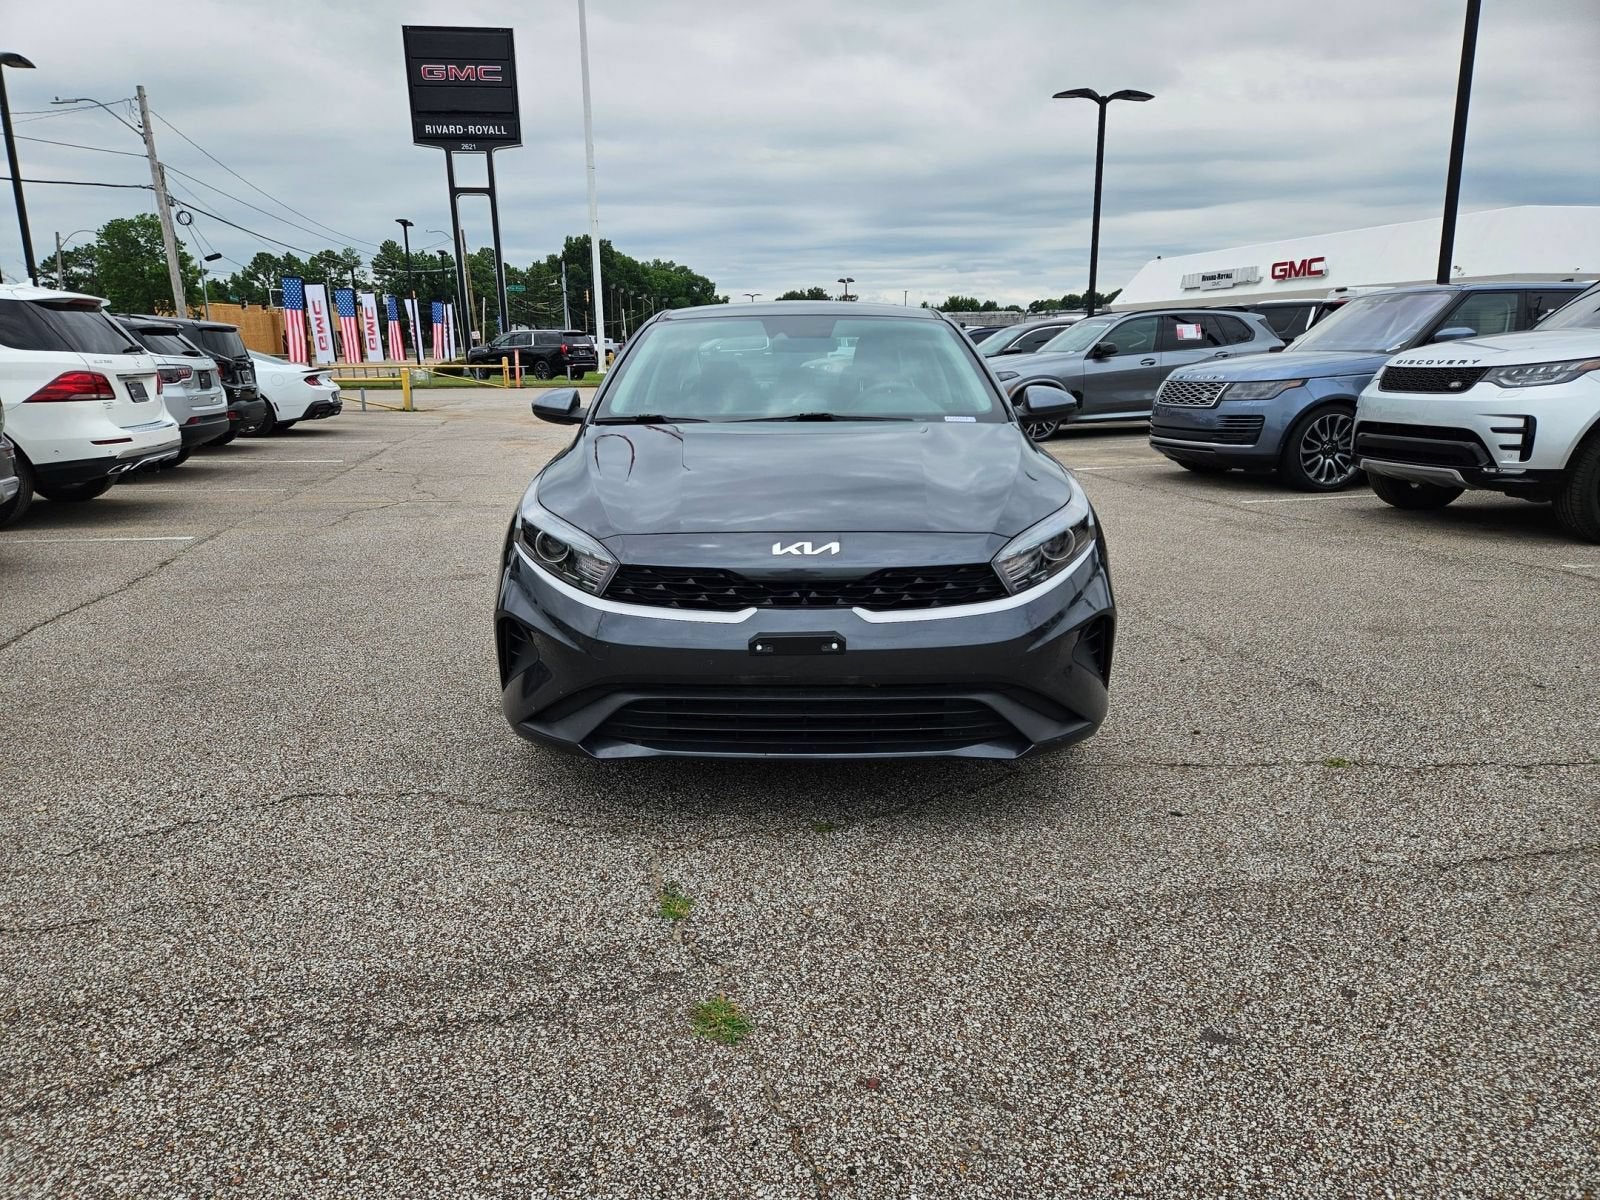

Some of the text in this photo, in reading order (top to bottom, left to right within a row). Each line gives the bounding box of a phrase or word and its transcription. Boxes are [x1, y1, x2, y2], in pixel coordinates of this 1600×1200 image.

[421, 64, 502, 81] GMC
[425, 124, 507, 134] RIVARD-ROYALL
[1271, 256, 1326, 281] GMC
[312, 300, 329, 351] GMC
[365, 306, 378, 351] GMC
[772, 541, 840, 555] KIA
